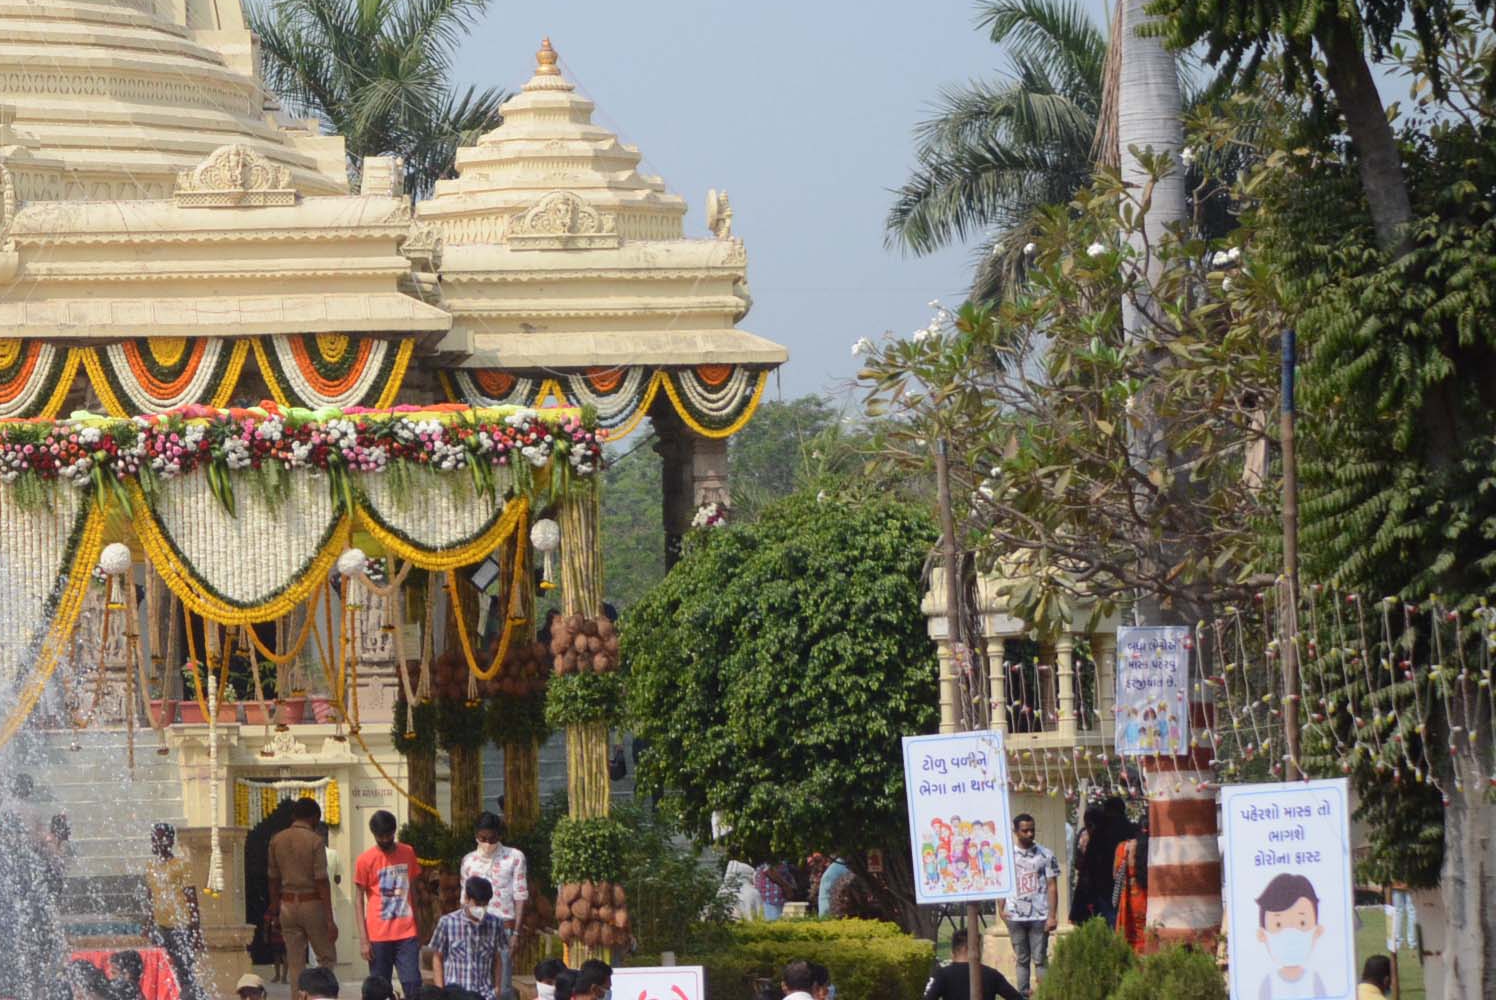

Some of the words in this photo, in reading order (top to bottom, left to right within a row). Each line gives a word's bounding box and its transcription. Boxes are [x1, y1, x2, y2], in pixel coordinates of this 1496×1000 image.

[922, 754, 948, 775] ટોળુ
[950, 750, 987, 769] વળીને
[919, 779, 947, 796] ભેગા
[951, 781, 965, 793] ના
[970, 779, 995, 793] થાવ
[1240, 802, 1279, 822] પહેરશો
[1283, 805, 1312, 819] માસ્ક
[1316, 799, 1331, 816] તો
[1268, 824, 1305, 842] ભાગશે
[1254, 849, 1290, 867] કોરોના
[1295, 850, 1321, 865] ફાસ્ટ
